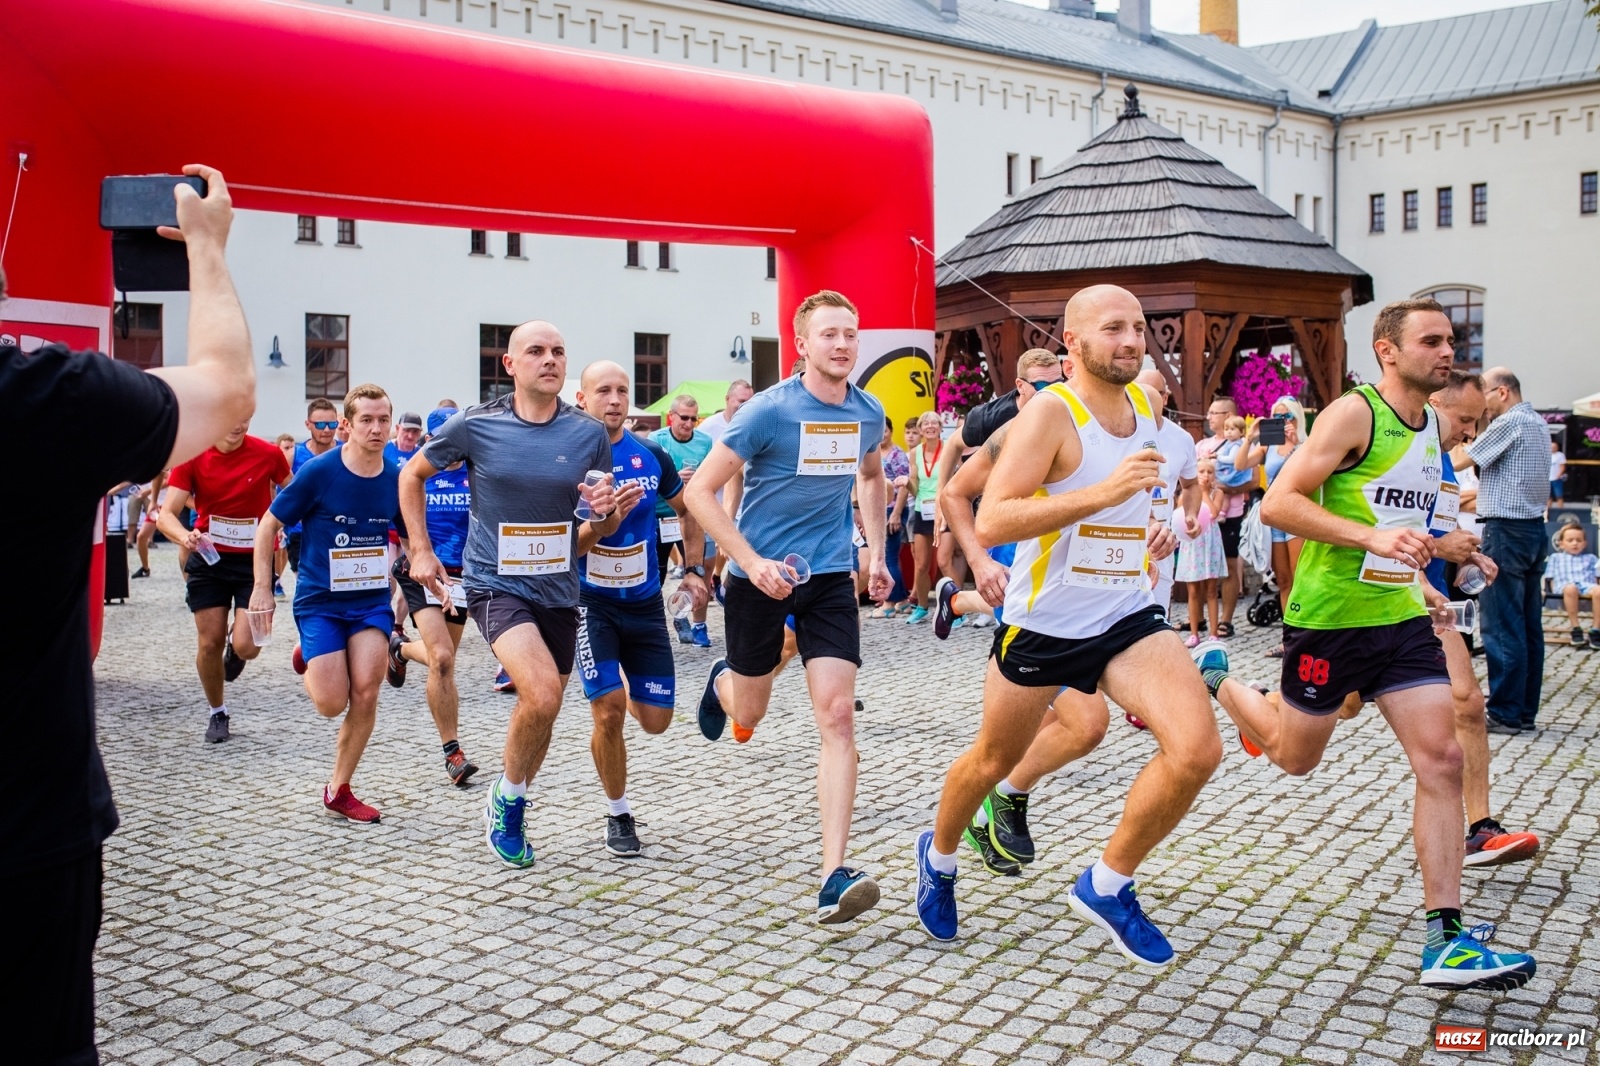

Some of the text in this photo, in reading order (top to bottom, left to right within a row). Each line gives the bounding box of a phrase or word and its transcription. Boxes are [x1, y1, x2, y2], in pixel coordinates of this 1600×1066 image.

[752, 312, 760, 326] B
[910, 371, 934, 398] SI
[830, 440, 837, 454] 3
[426, 494, 471, 505] NNER
[226, 527, 238, 536] 56
[528, 542, 545, 556] 10
[1104, 548, 1124, 564] 39
[353, 563, 368, 574] 26
[614, 563, 622, 573] 6
[1298, 654, 1330, 685] 88
